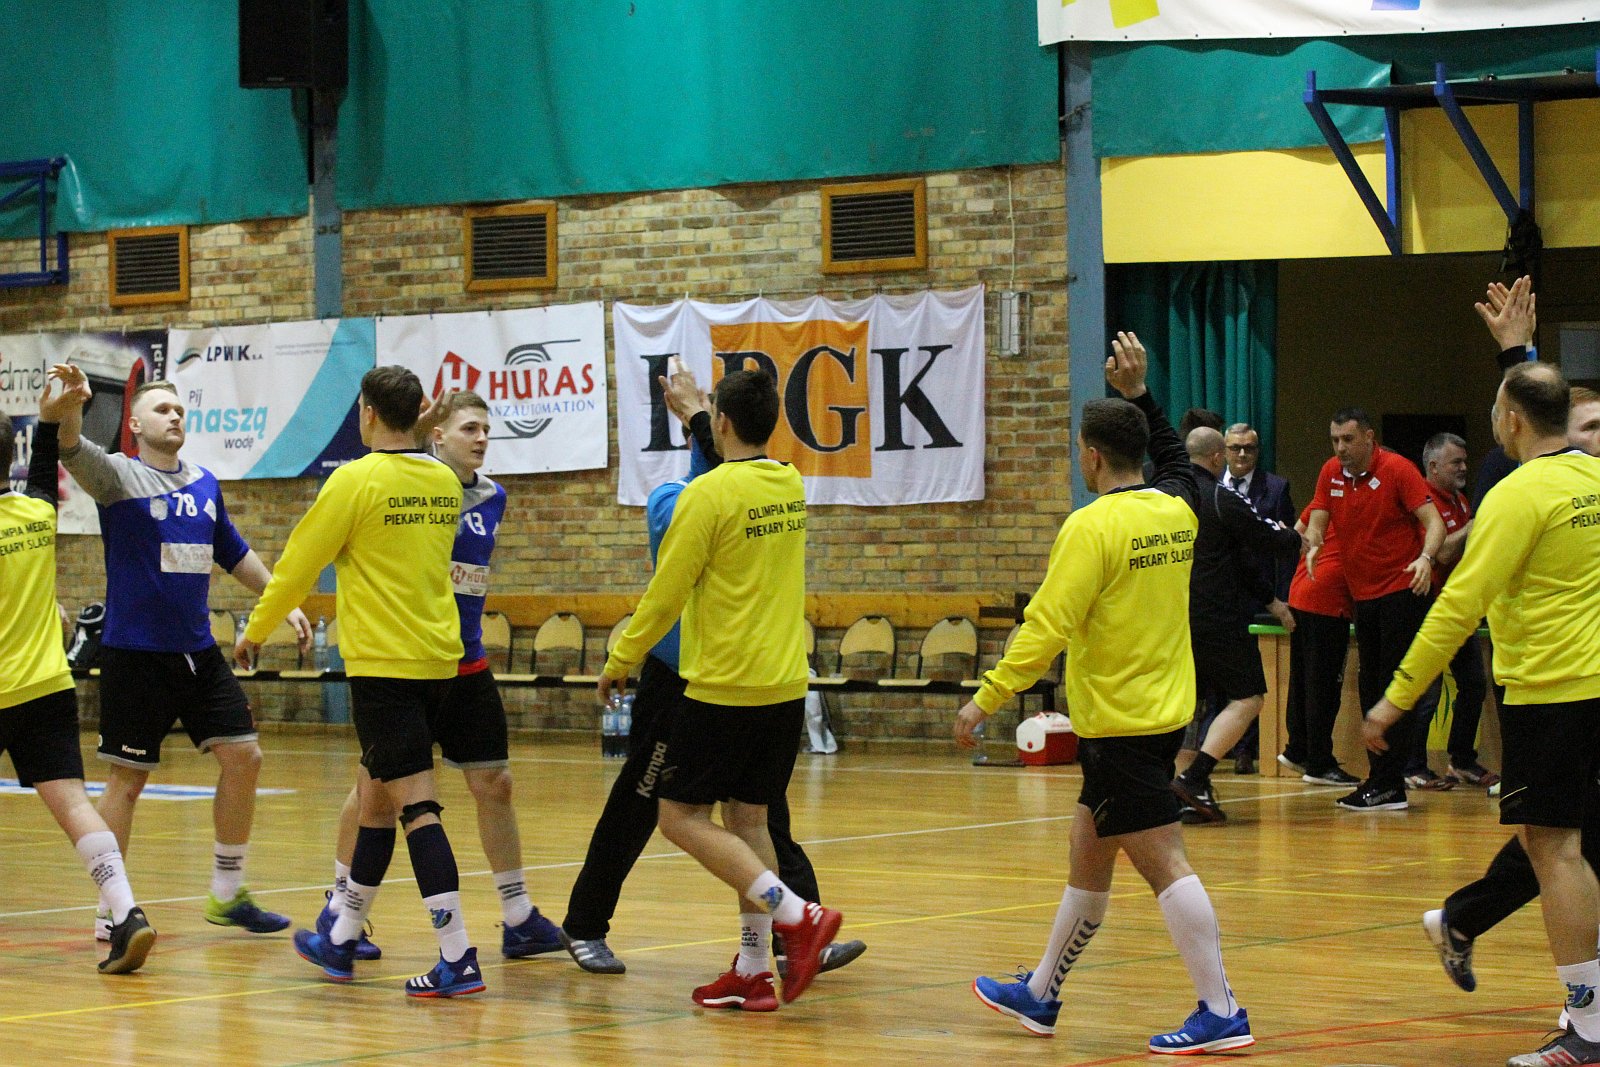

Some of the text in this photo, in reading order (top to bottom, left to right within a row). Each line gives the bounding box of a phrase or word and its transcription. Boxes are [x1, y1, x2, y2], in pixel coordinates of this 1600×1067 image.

[0, 359, 46, 391] dmel
[489, 363, 595, 400] HURAS
[189, 389, 203, 408] Pij
[487, 400, 595, 417] ANZAUTOMATION
[185, 406, 268, 439] naszą
[172, 493, 198, 517] 78
[388, 496, 428, 508] OLIMPIA
[384, 513, 425, 526] PIEKARY
[748, 503, 785, 521] OLIMPIA
[746, 521, 784, 539] PIEKARY
[1131, 533, 1169, 551] OLIMPIA
[1129, 552, 1168, 571] PIEKARY
[121, 744, 147, 757] Kempa
[636, 741, 667, 798] Kempa
